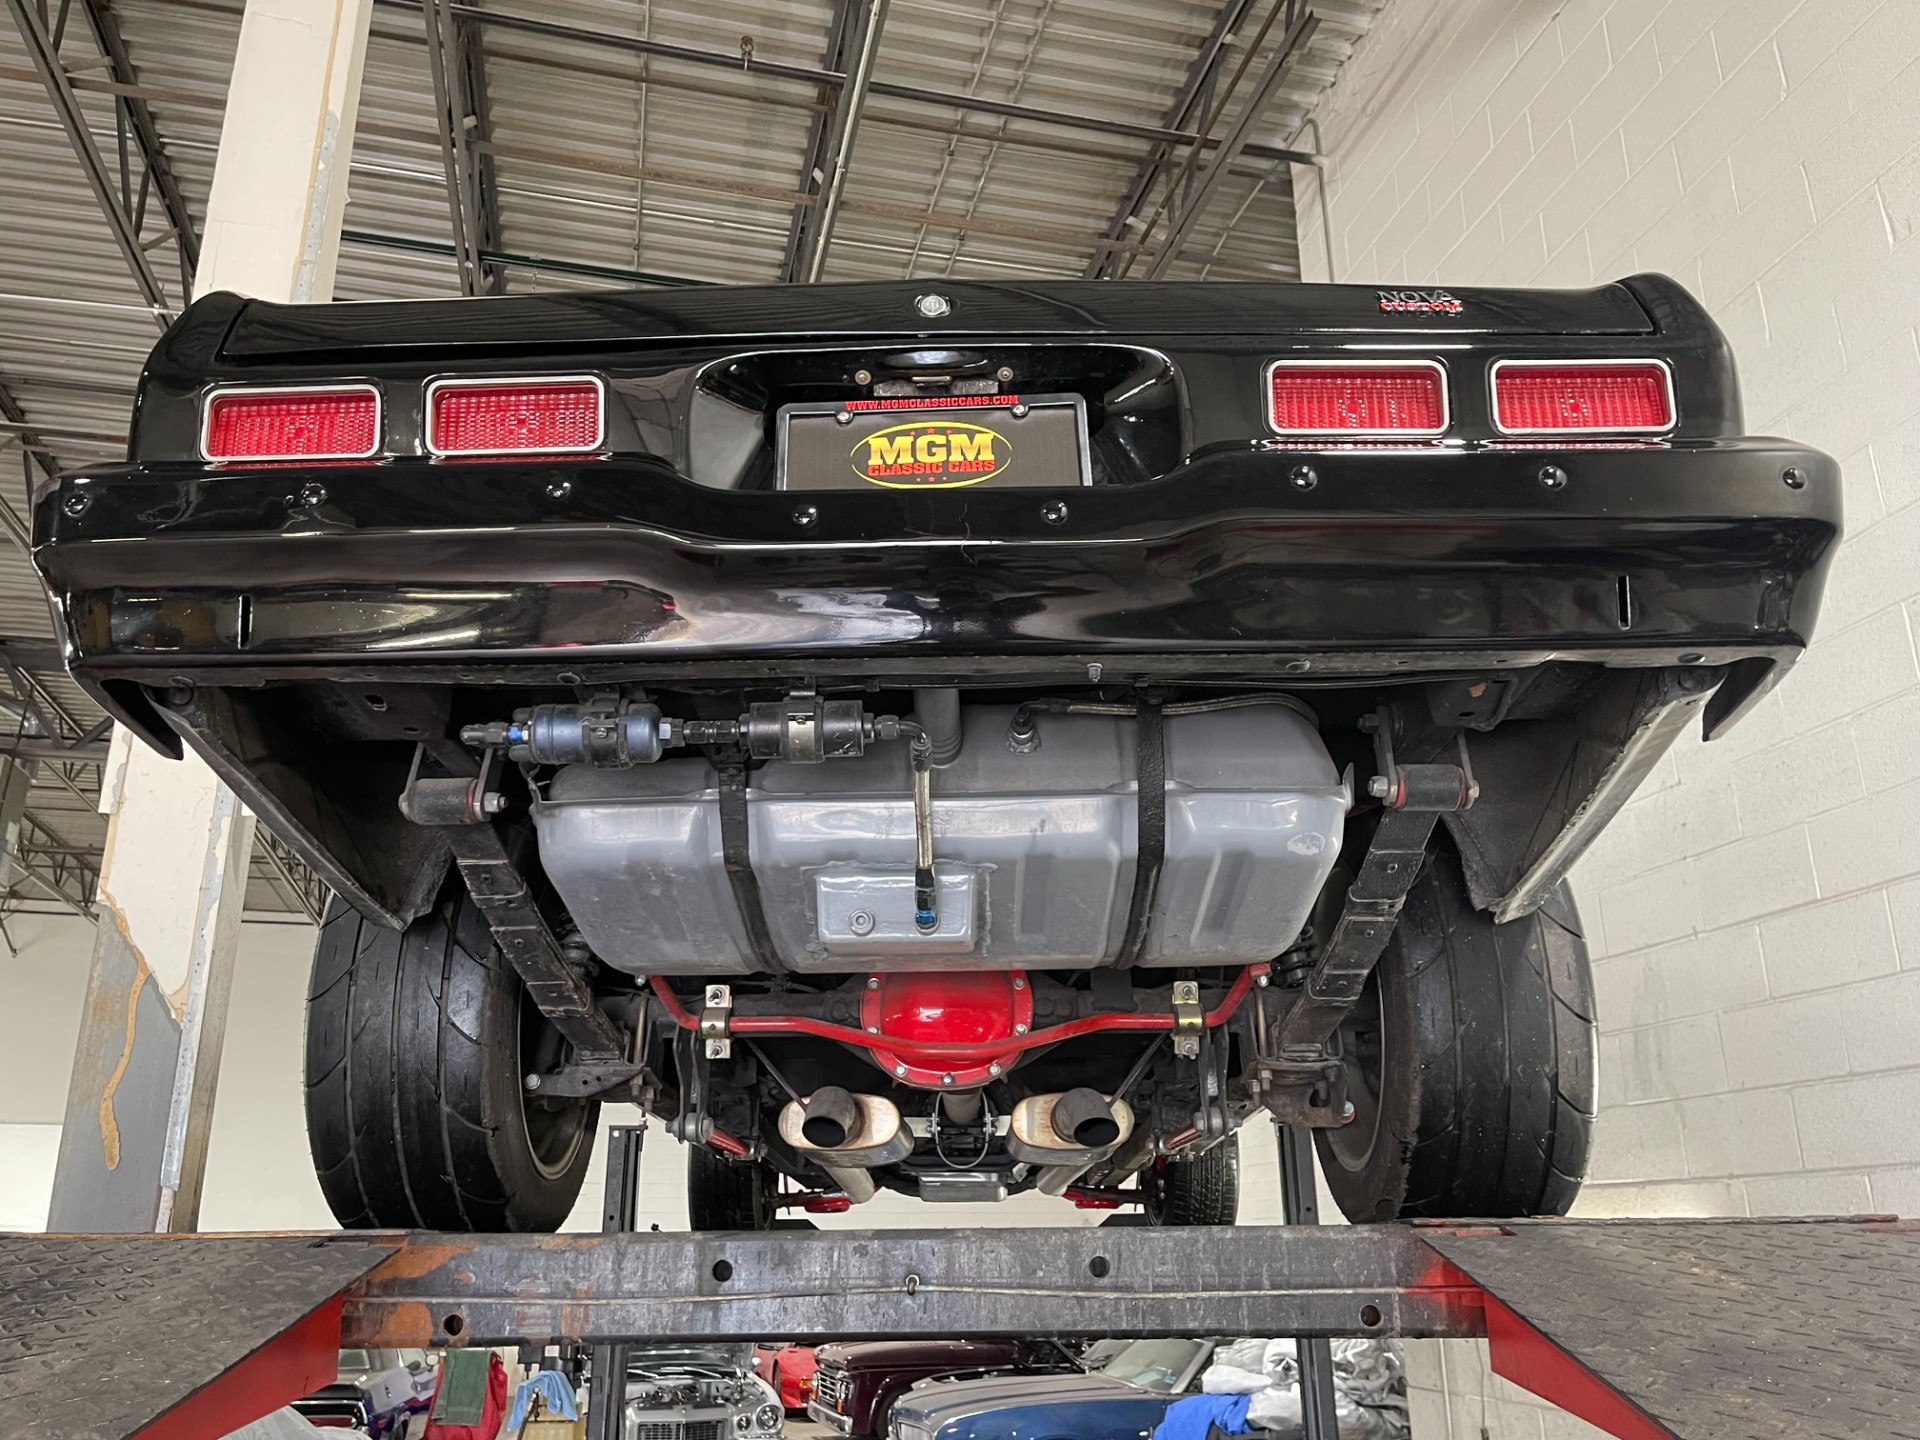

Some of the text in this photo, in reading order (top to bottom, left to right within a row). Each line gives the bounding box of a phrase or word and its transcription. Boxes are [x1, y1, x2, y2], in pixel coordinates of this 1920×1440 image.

[1377, 290, 1461, 302] NOVA
[846, 395, 1018, 410] WWW.MGMCLASSICCARS.COM
[868, 433, 995, 465] MGM
[867, 460, 996, 476] CLASSIC CARS
